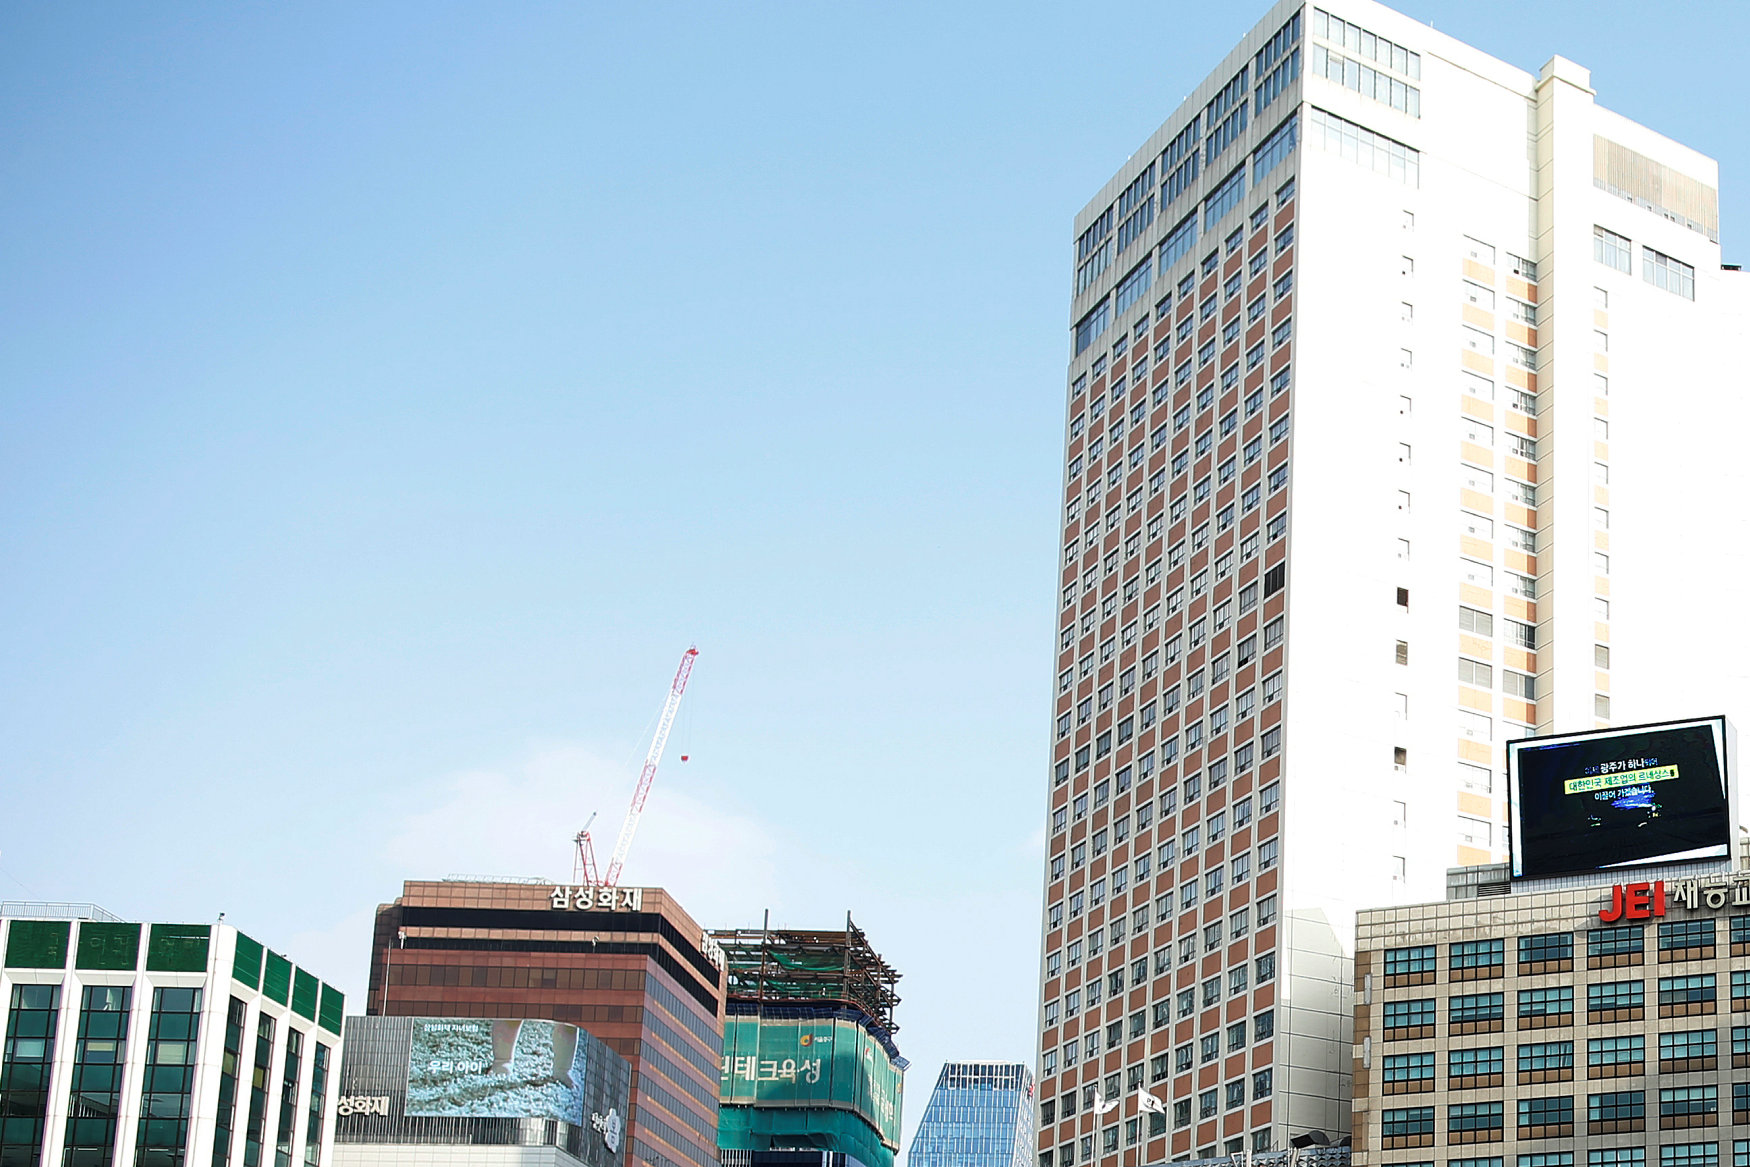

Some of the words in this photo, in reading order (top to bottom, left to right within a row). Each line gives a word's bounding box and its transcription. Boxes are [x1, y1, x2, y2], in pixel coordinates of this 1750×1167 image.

[1600, 760, 1627, 774] 광주가
[1570, 777, 1602, 792] 대한민국
[550, 886, 643, 912] 삼성화재
[1599, 880, 1665, 923] JEI
[428, 1060, 453, 1074] 우리
[458, 1060, 484, 1074] 아이
